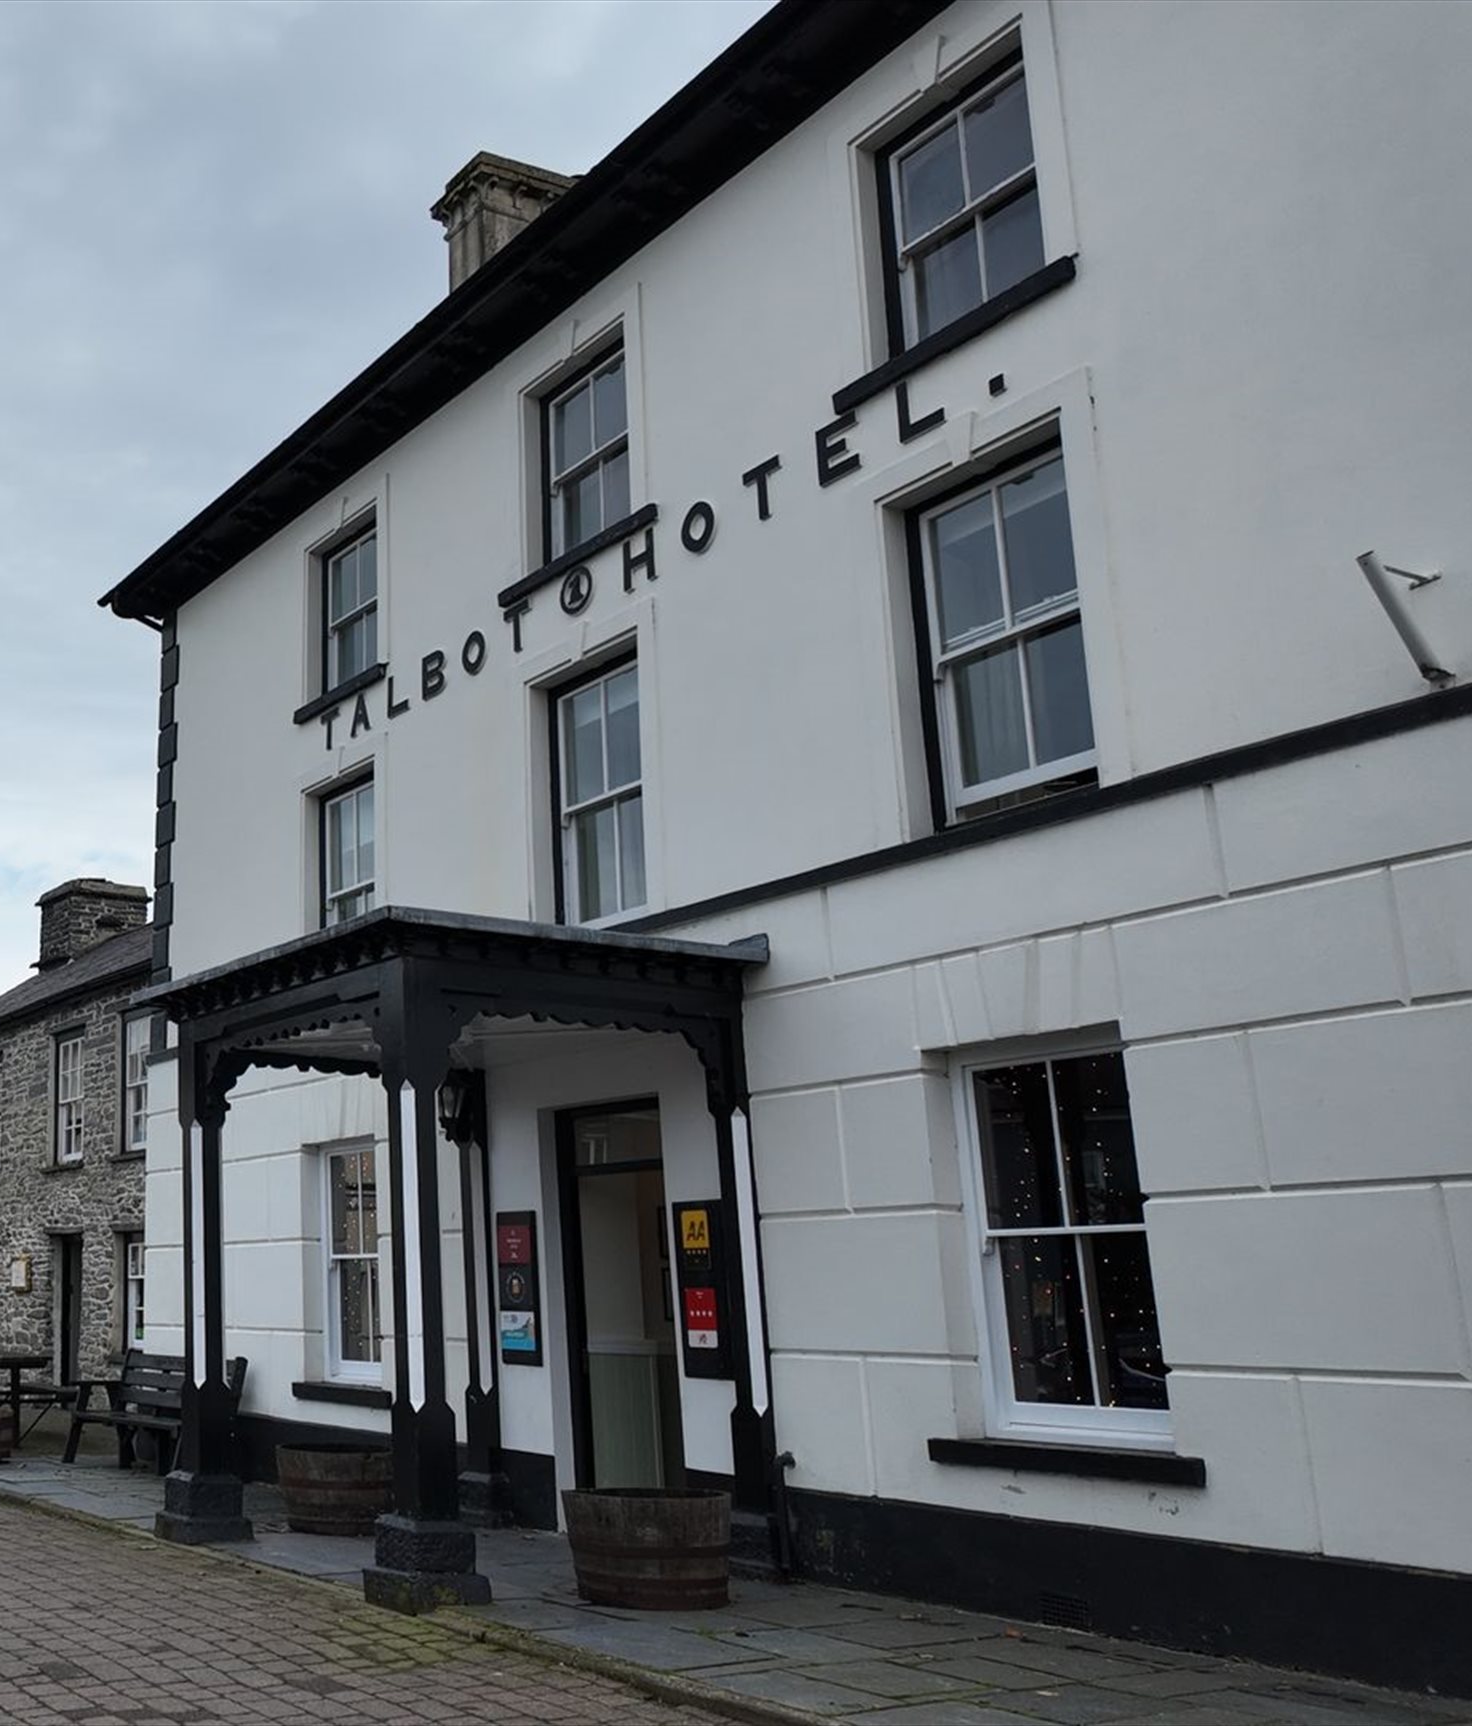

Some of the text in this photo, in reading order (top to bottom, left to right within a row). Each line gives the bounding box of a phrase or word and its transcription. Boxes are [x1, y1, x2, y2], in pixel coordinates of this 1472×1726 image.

[320, 373, 1009, 750] TALBOT HOTEL.
[686, 1220, 706, 1241] AA
